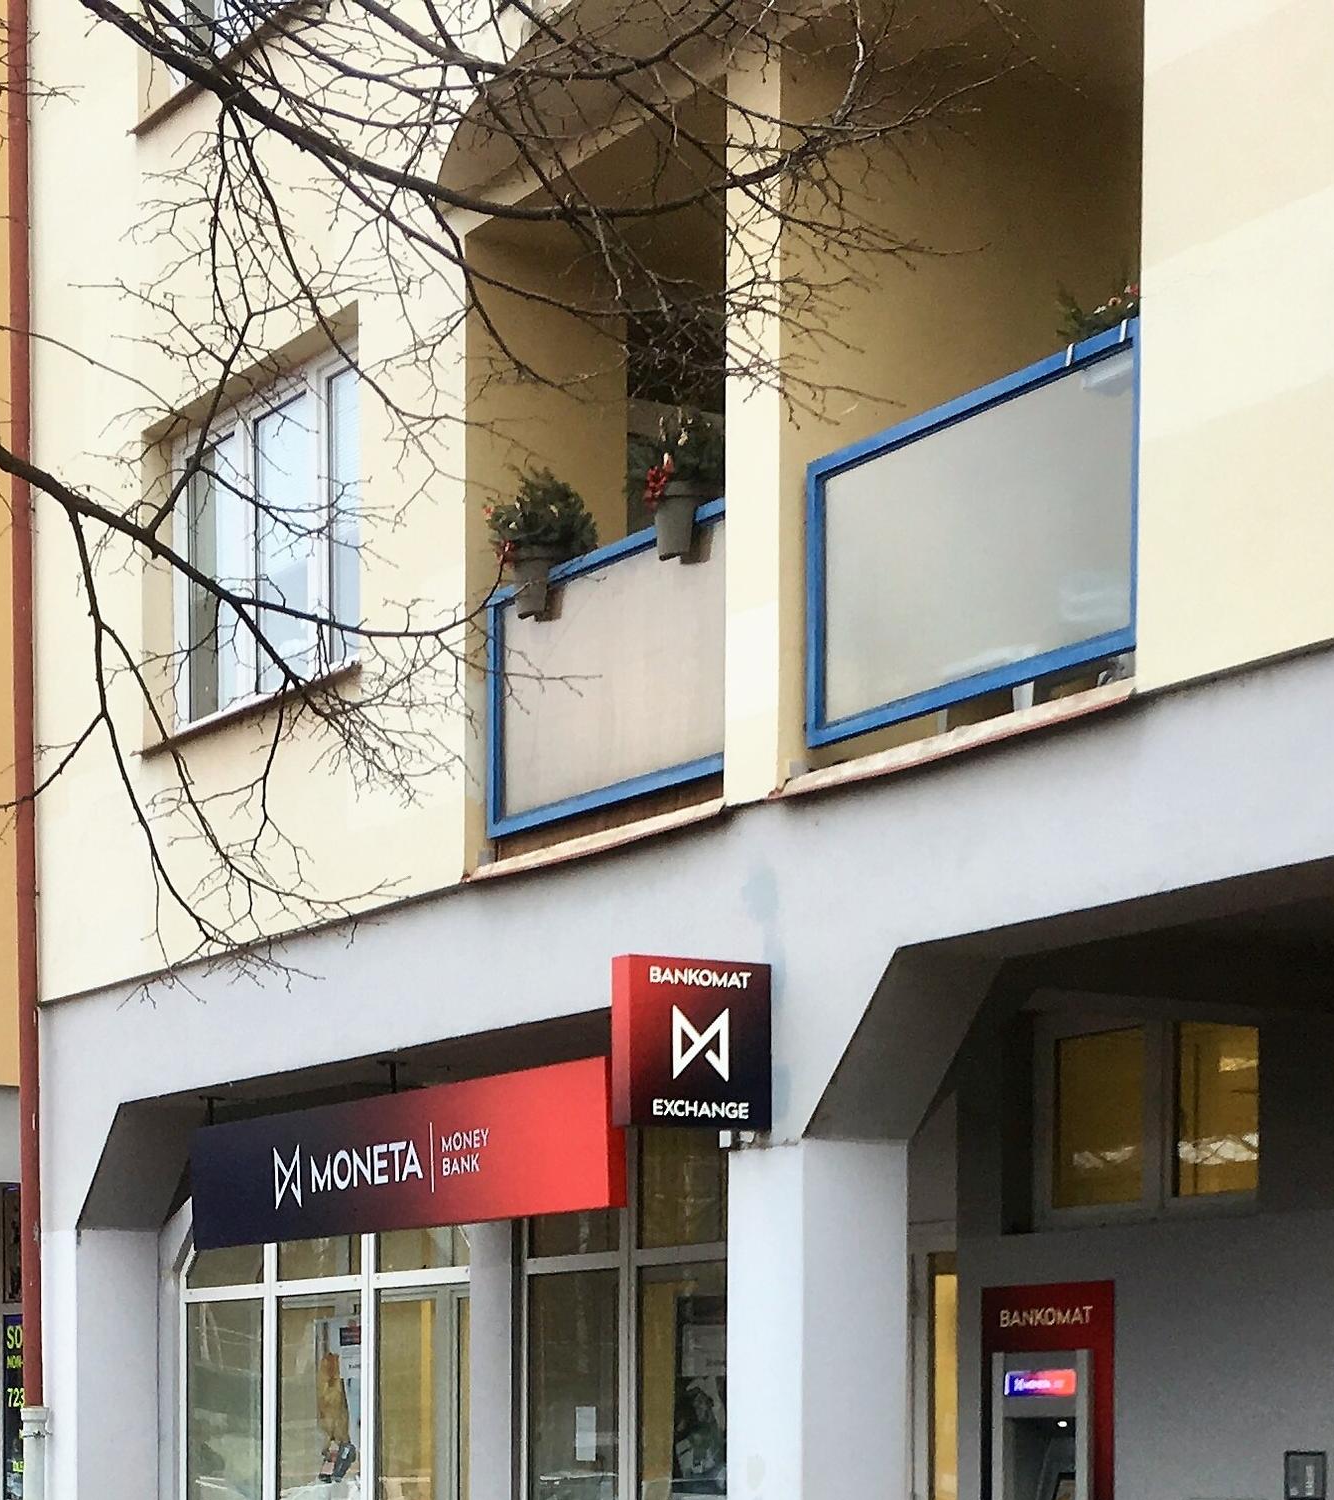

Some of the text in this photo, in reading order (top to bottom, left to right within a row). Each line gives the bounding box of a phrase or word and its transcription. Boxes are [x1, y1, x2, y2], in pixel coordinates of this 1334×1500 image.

[649, 965, 752, 989] BANKOMAT
[652, 1098, 750, 1120] EXCHANGE
[441, 1128, 490, 1153] MONEY
[310, 1140, 424, 1193] MONETA
[441, 1152, 481, 1177] BANK
[999, 1305, 1094, 1328] BANKOMAT
